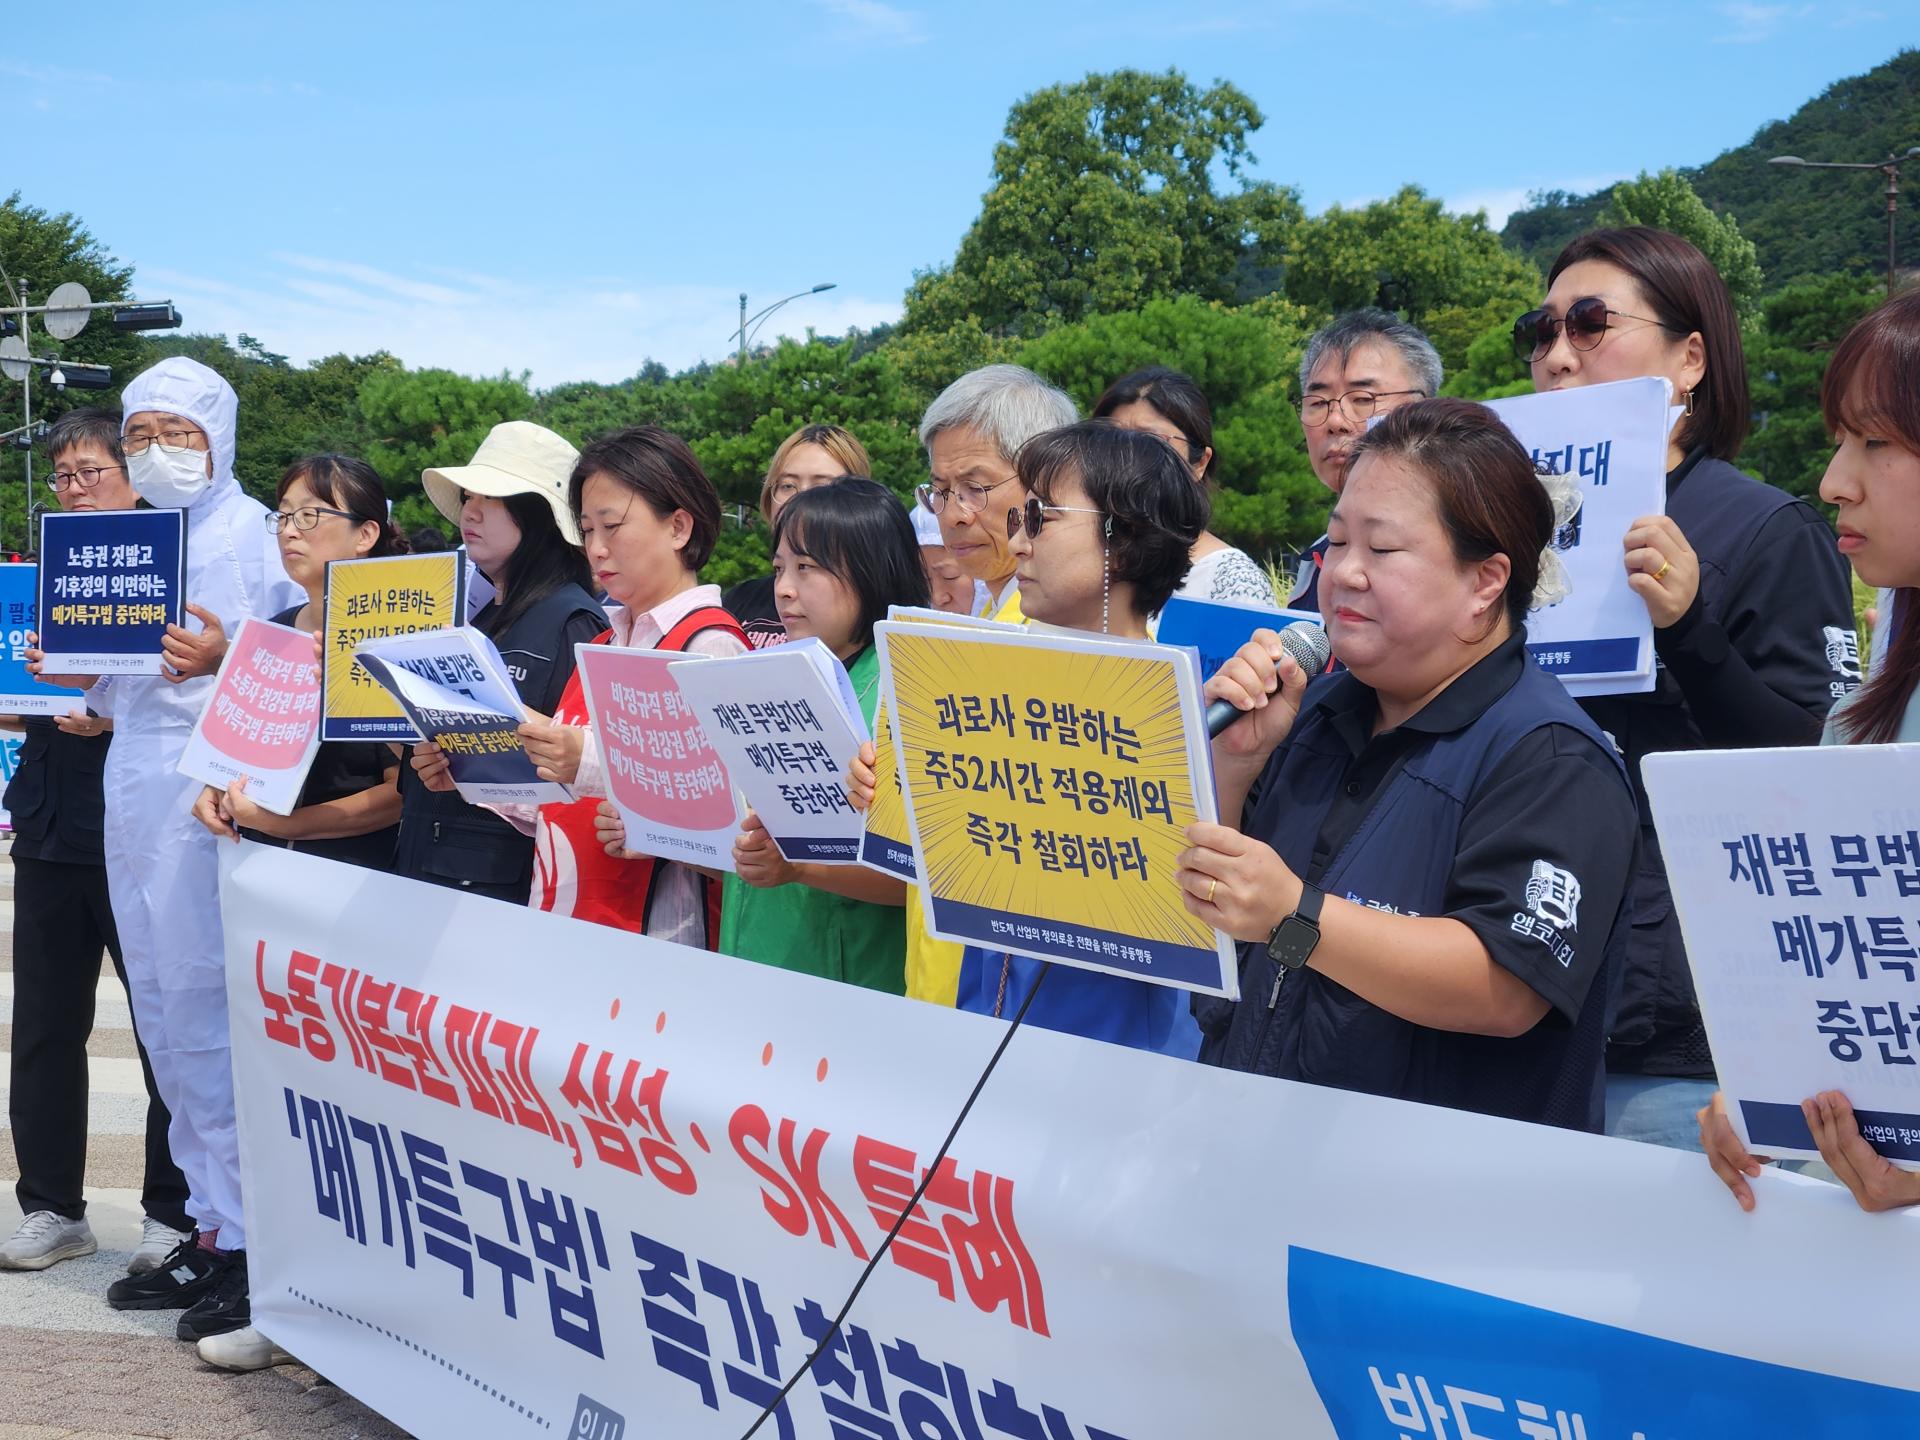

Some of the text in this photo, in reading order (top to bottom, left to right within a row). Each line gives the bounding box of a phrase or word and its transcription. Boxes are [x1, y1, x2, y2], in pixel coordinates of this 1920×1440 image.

[1532, 440, 1612, 486] 지대
[67, 544, 153, 567] 노동권 짓밟고
[54, 573, 167, 598] 기후정의 외면하는
[347, 588, 435, 618] 과로사 유발하는
[52, 604, 167, 626] 메가특구법 중단하라
[252, 647, 294, 684] 비정규직
[1538, 652, 1572, 665] 공동행동
[229, 665, 262, 704] 노동자
[257, 687, 294, 714] 건강권
[611, 681, 663, 721] 비정규직
[215, 692, 311, 745] 메가특구법 중단하라
[606, 710, 645, 753] 노동자
[646, 729, 687, 759] 건강권
[712, 698, 823, 735] 재벌 무법지대
[935, 693, 1142, 764] 과로사 유발하는
[609, 745, 725, 800] 메가특구법 중단하라
[745, 741, 839, 774] 메가특구법
[778, 783, 855, 815] 중단하라
[925, 750, 1046, 804] 주52시간
[1052, 768, 1174, 825] 적용제외
[966, 811, 1149, 881] 즉각 철회하라
[1722, 830, 1920, 898] 재벌 무법
[991, 919, 1153, 965] 반도체 산업의 정의로운 전환을 위한 공동행동
[1511, 912, 1575, 968] 앰코지회
[1772, 914, 1920, 983] 메가특
[255, 940, 461, 1108] 노동기본권
[852, 1134, 1052, 1339] 특혜
[1864, 1125, 1897, 1143] 산업의
[630, 1229, 799, 1440] 즉각
[793, 1297, 1130, 1440] 철회
